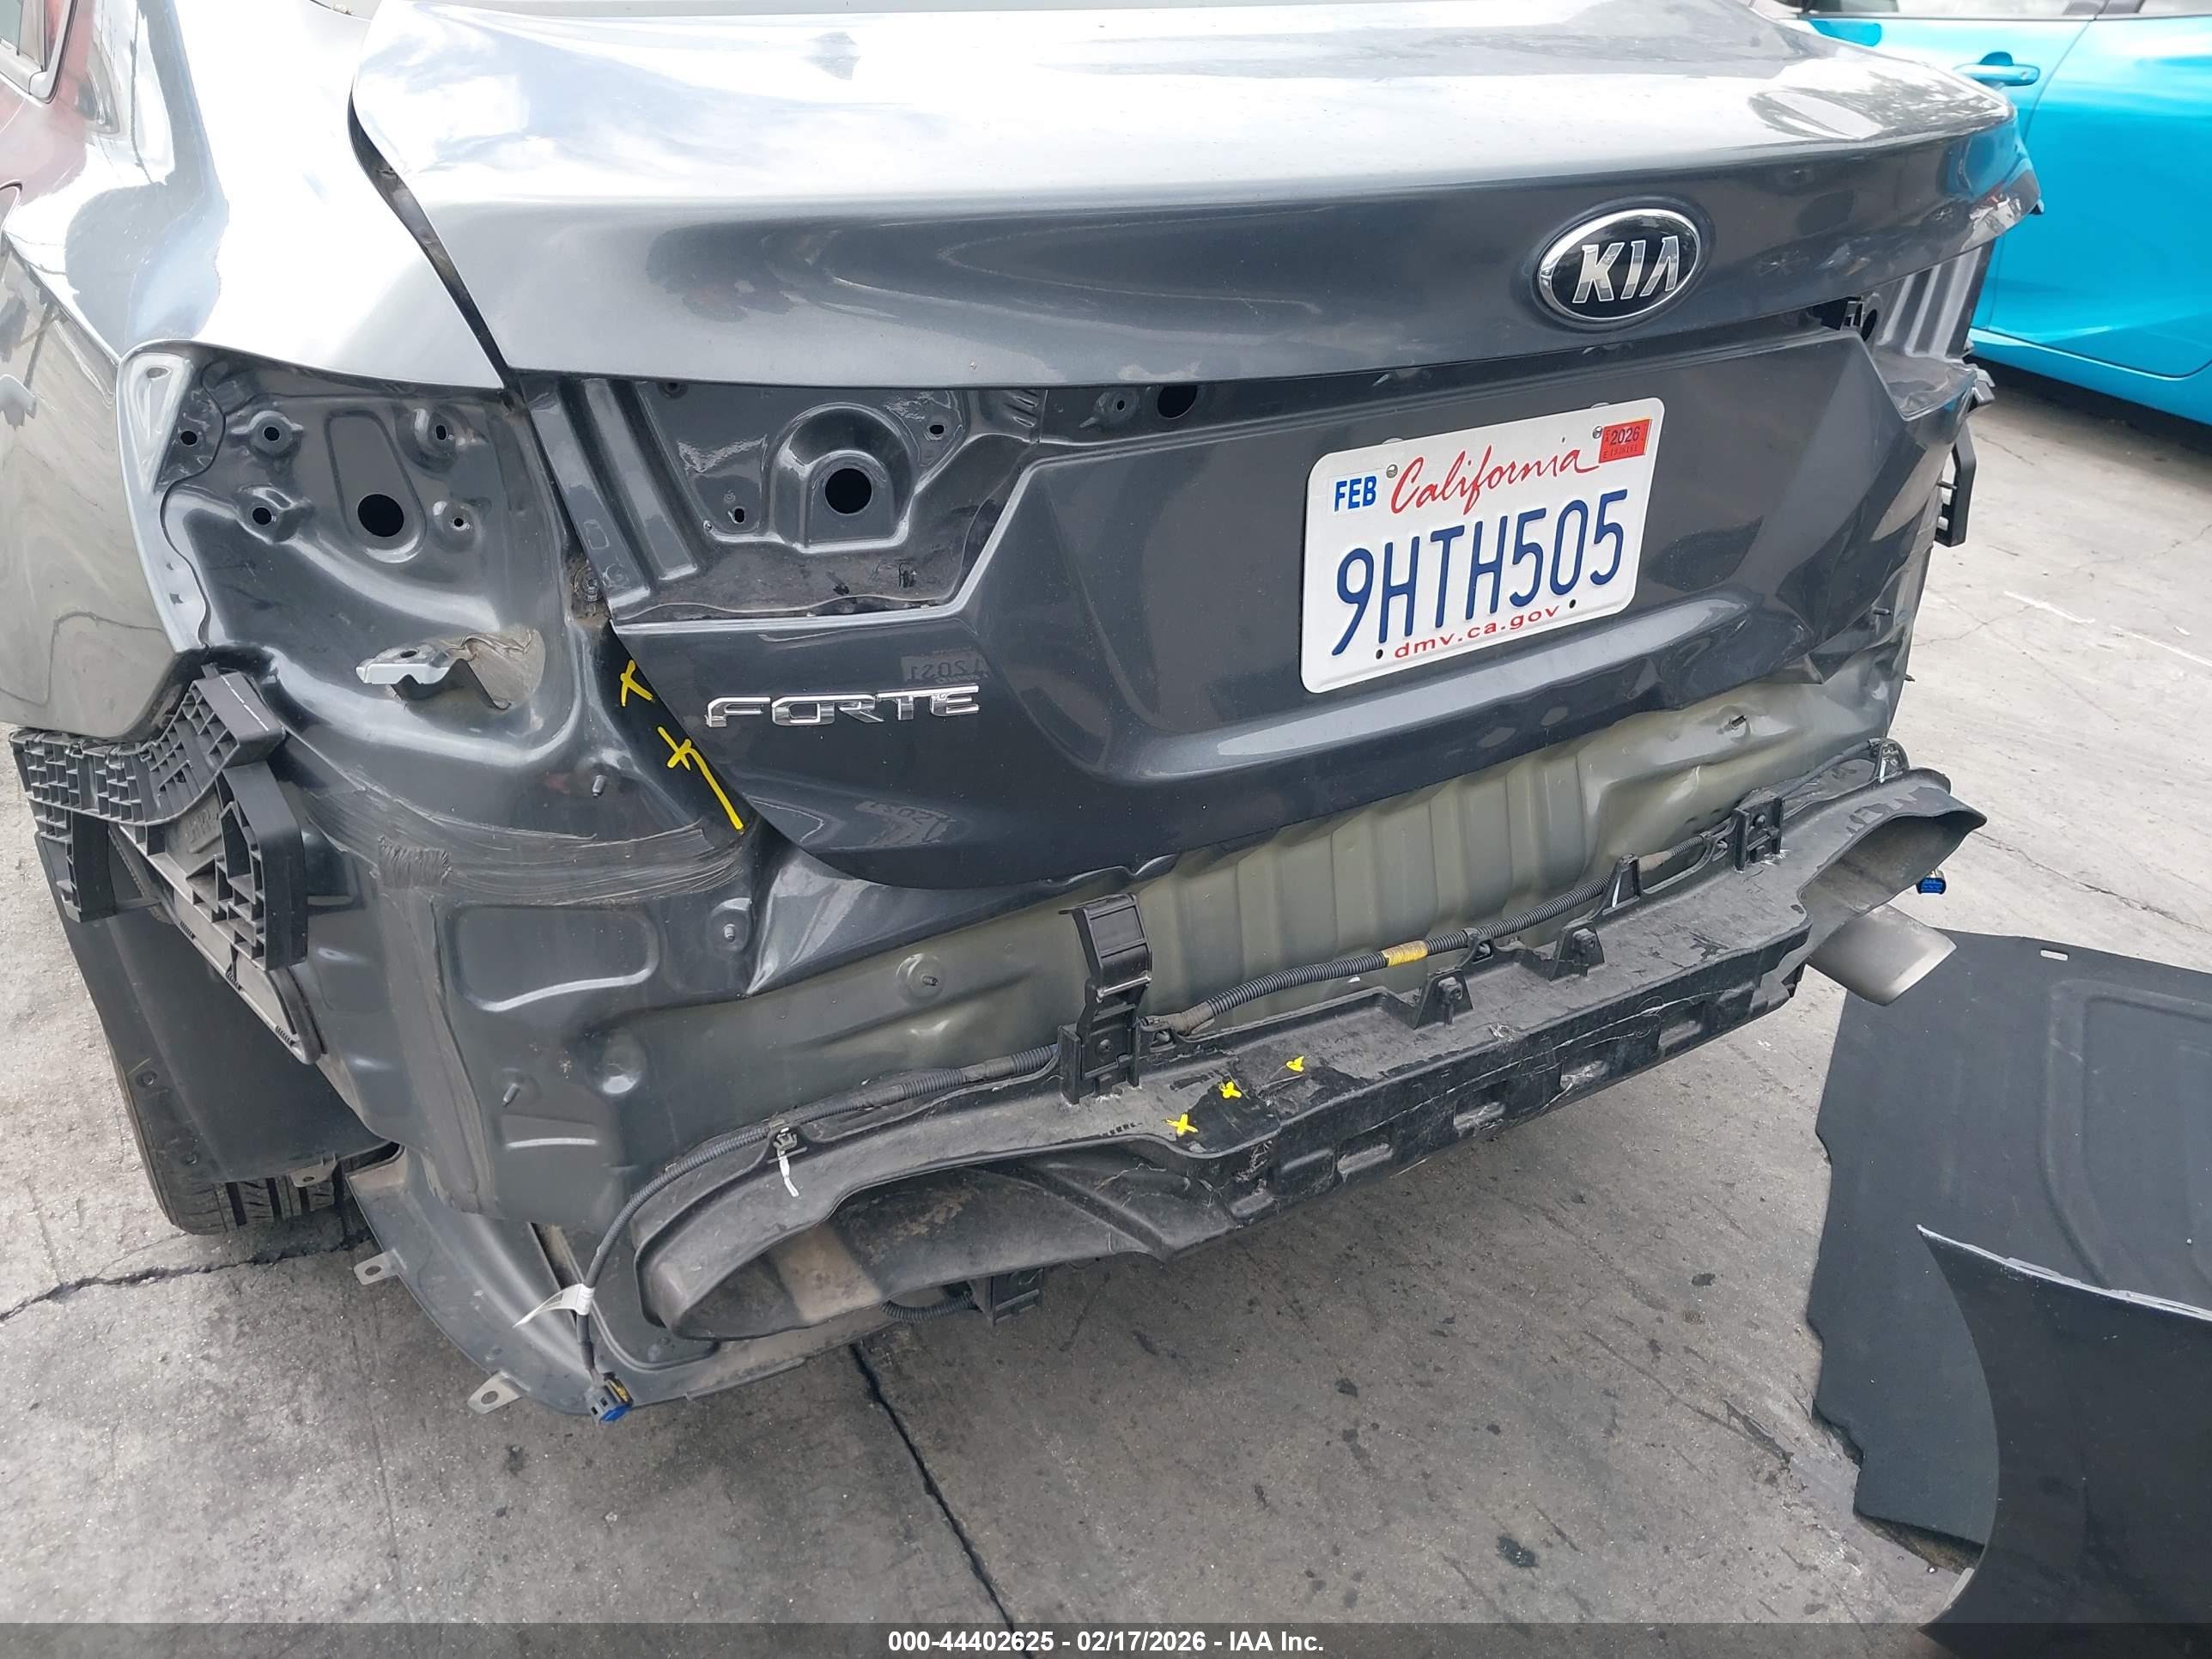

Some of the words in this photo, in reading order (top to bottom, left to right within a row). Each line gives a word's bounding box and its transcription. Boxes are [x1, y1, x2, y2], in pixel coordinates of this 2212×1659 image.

[1572, 235, 1680, 304] KIA
[1609, 426, 1641, 447] 2026
[1334, 476, 1378, 510] FEB
[1391, 438, 1599, 515] California
[1333, 490, 1627, 655] 9HTH505
[1395, 604, 1560, 659] dmv.ca.gov
[705, 684, 980, 728] FORTE
